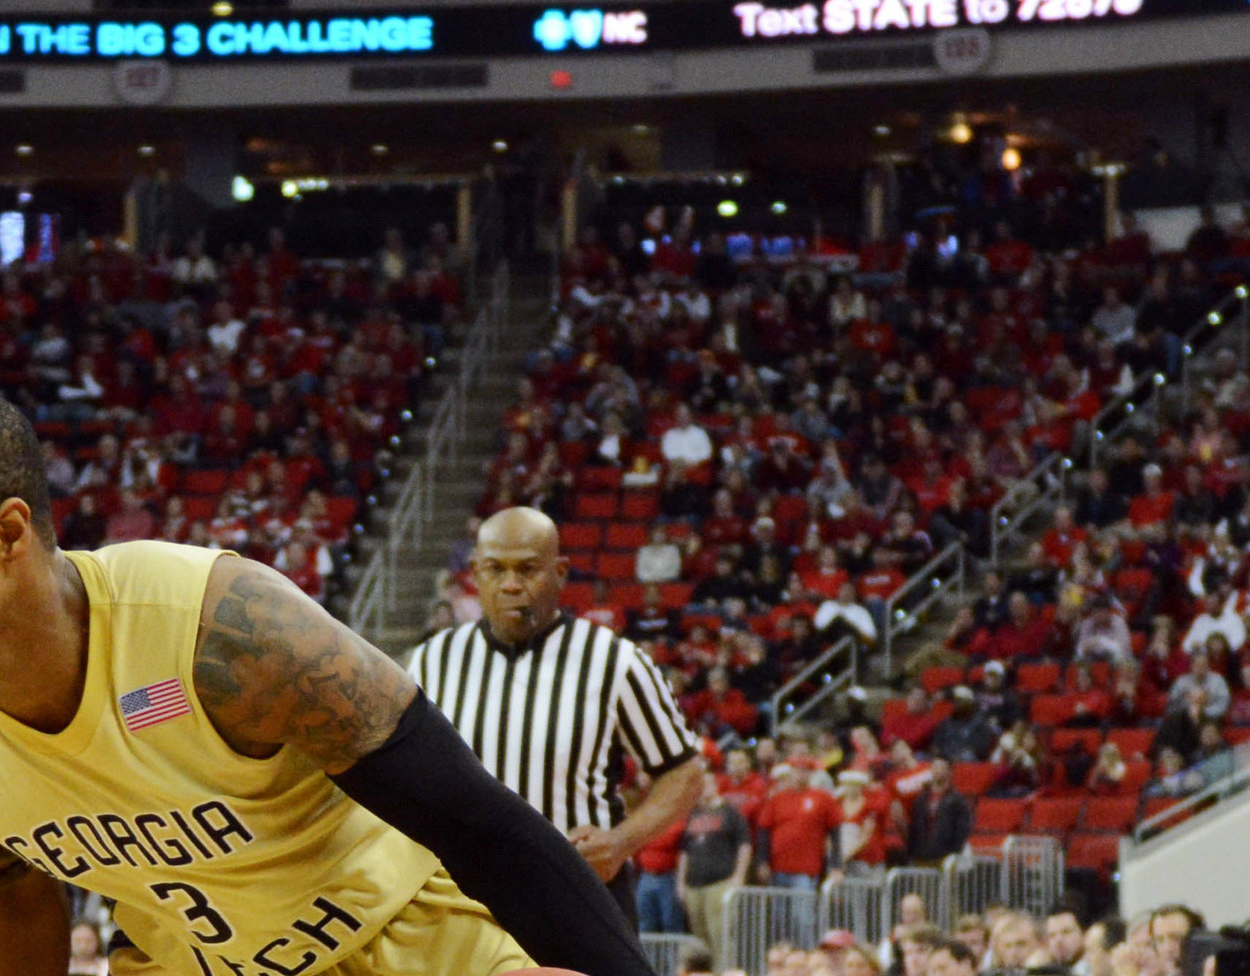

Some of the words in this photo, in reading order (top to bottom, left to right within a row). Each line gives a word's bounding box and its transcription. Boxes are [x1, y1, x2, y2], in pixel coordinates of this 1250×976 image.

[15, 24, 91, 55] THE
[96, 22, 165, 57] BIG
[171, 23, 200, 57] 3
[206, 16, 433, 56] CHALLENGE
[602, 11, 647, 43] NC
[734, 3, 818, 37] Text
[823, 0, 958, 34] STATE
[149, 882, 233, 944] 3
